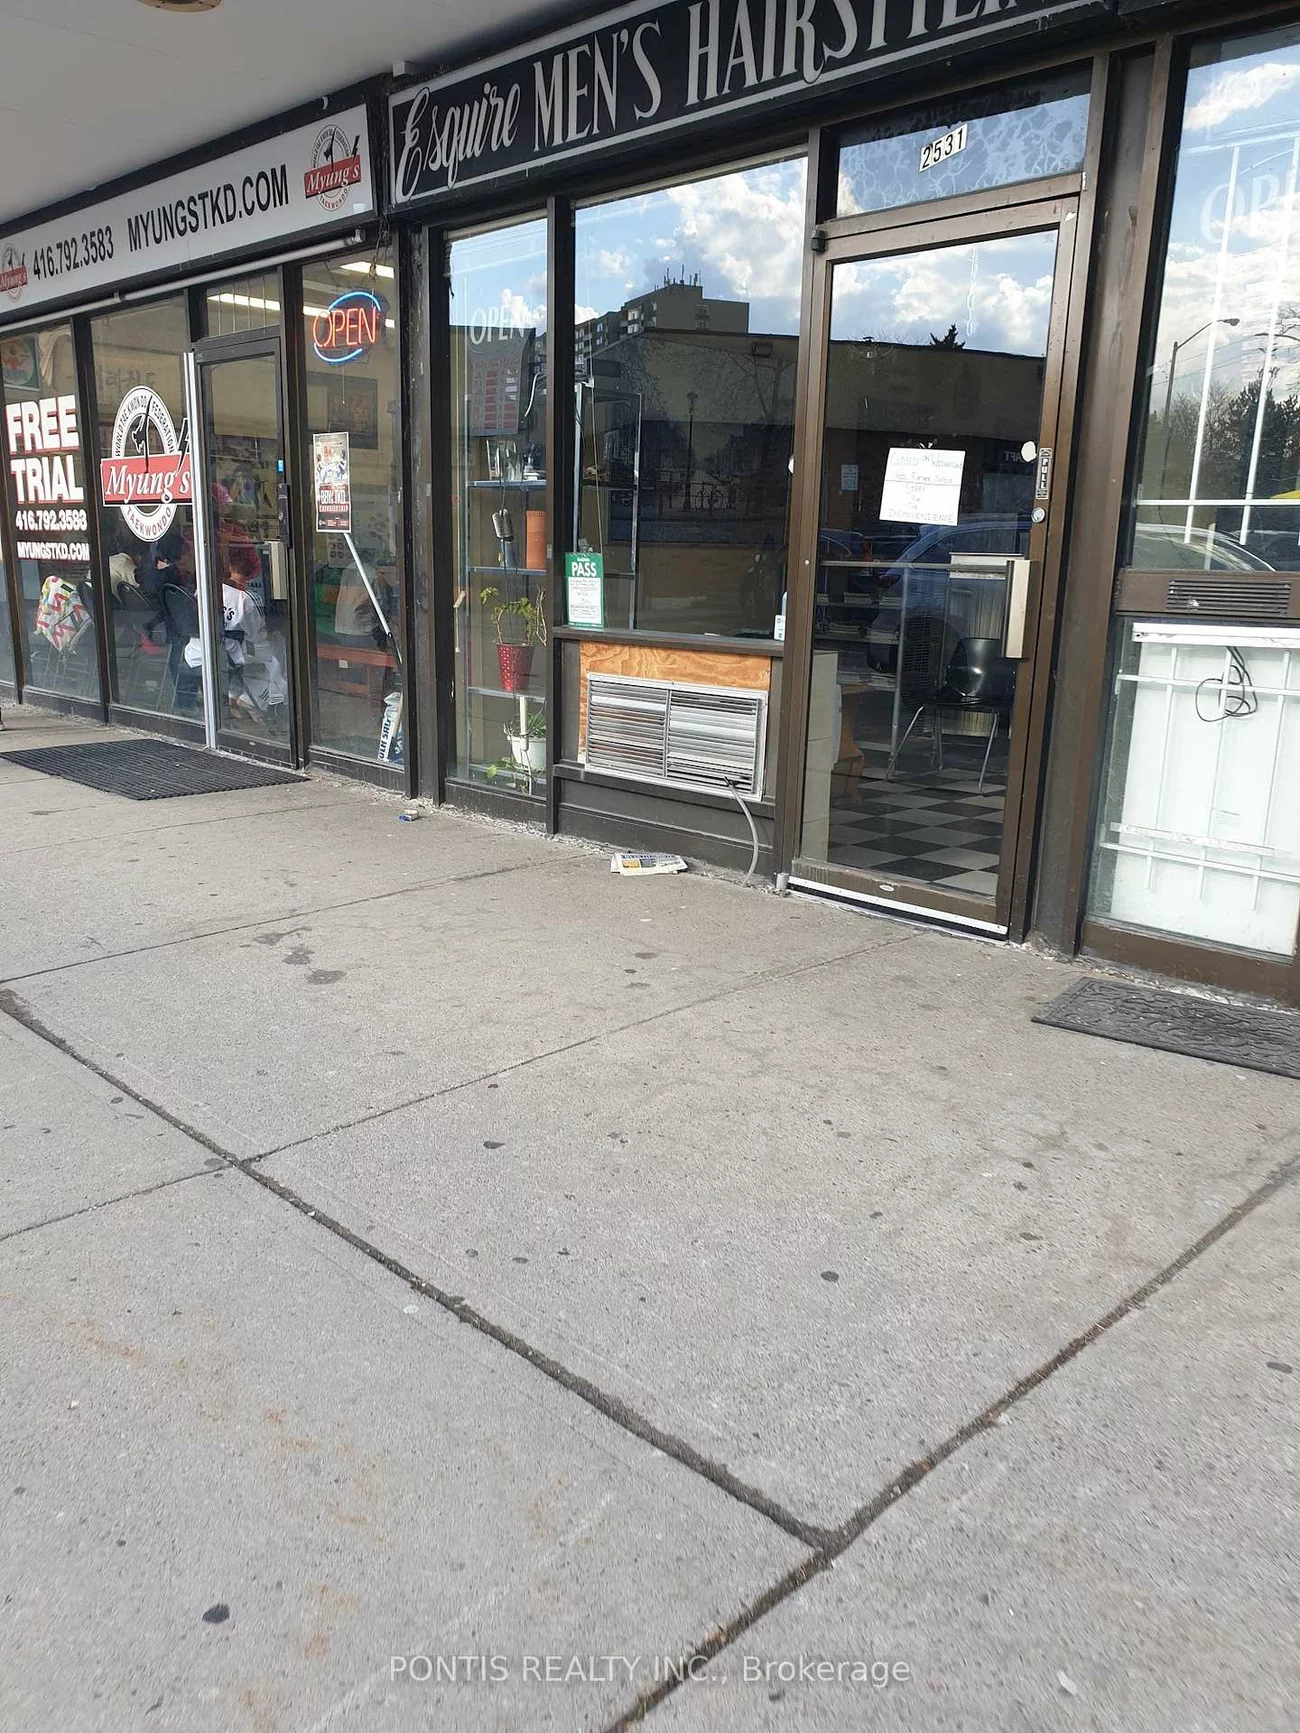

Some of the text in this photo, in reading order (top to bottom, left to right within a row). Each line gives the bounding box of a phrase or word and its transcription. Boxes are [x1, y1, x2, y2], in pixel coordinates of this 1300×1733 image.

[396, 86, 521, 202] Esquire
[533, 20, 662, 152] MEN'S
[921, 129, 965, 170] 2531
[33, 163, 290, 281] 416.792.3583 MYUNGSTKD.COM
[313, 307, 376, 348] OPEN
[469, 304, 526, 345] OPEN
[5, 394, 80, 455] FREE
[10, 454, 85, 504] TRIAL
[105, 464, 190, 504] Myung's
[1040, 457, 1049, 489] PULL
[15, 508, 88, 531] 416.792.3583
[126, 505, 172, 536] TAEKWONDO
[17, 540, 91, 561] MYUNGSTKD.COM
[571, 561, 598, 577] PASS
